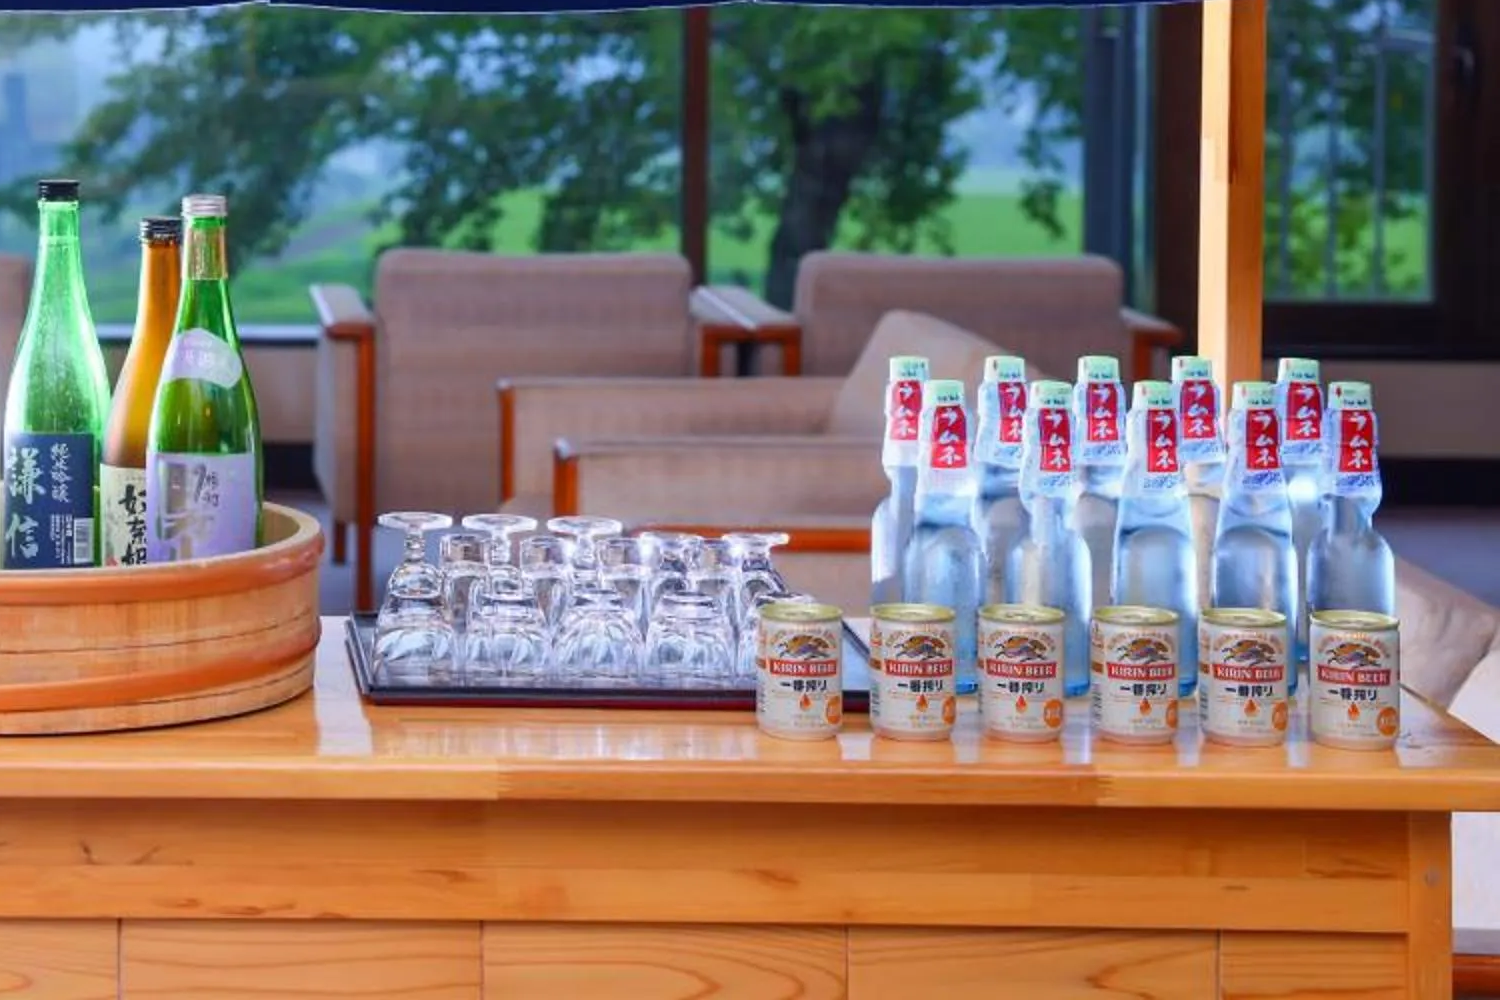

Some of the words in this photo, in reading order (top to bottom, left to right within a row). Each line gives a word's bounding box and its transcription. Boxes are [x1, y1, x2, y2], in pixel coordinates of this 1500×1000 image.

[773, 660, 807, 675] KIRIN
[888, 660, 923, 675] KIRIN
[989, 661, 1023, 676] KIRIN
[1111, 664, 1146, 678] KIRIN
[1217, 666, 1251, 681] KIRIN
[1321, 668, 1355, 683] KIRIN
